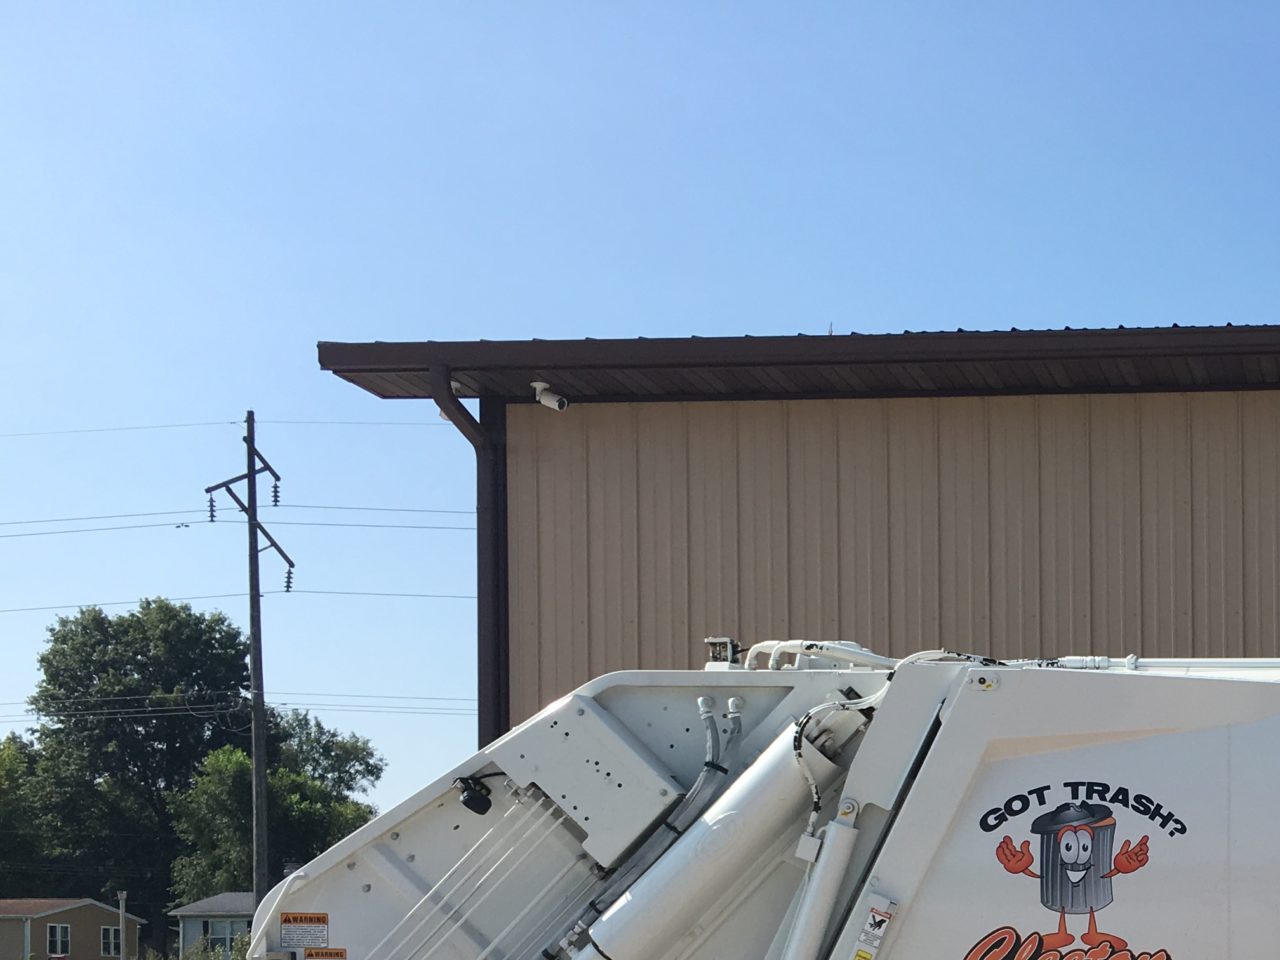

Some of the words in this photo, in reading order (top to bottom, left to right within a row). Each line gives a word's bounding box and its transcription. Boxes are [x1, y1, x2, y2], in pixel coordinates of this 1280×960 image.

[979, 785, 1051, 833] GOT
[1063, 781, 1188, 837] TRASH?
[292, 915, 327, 924] WARNING
